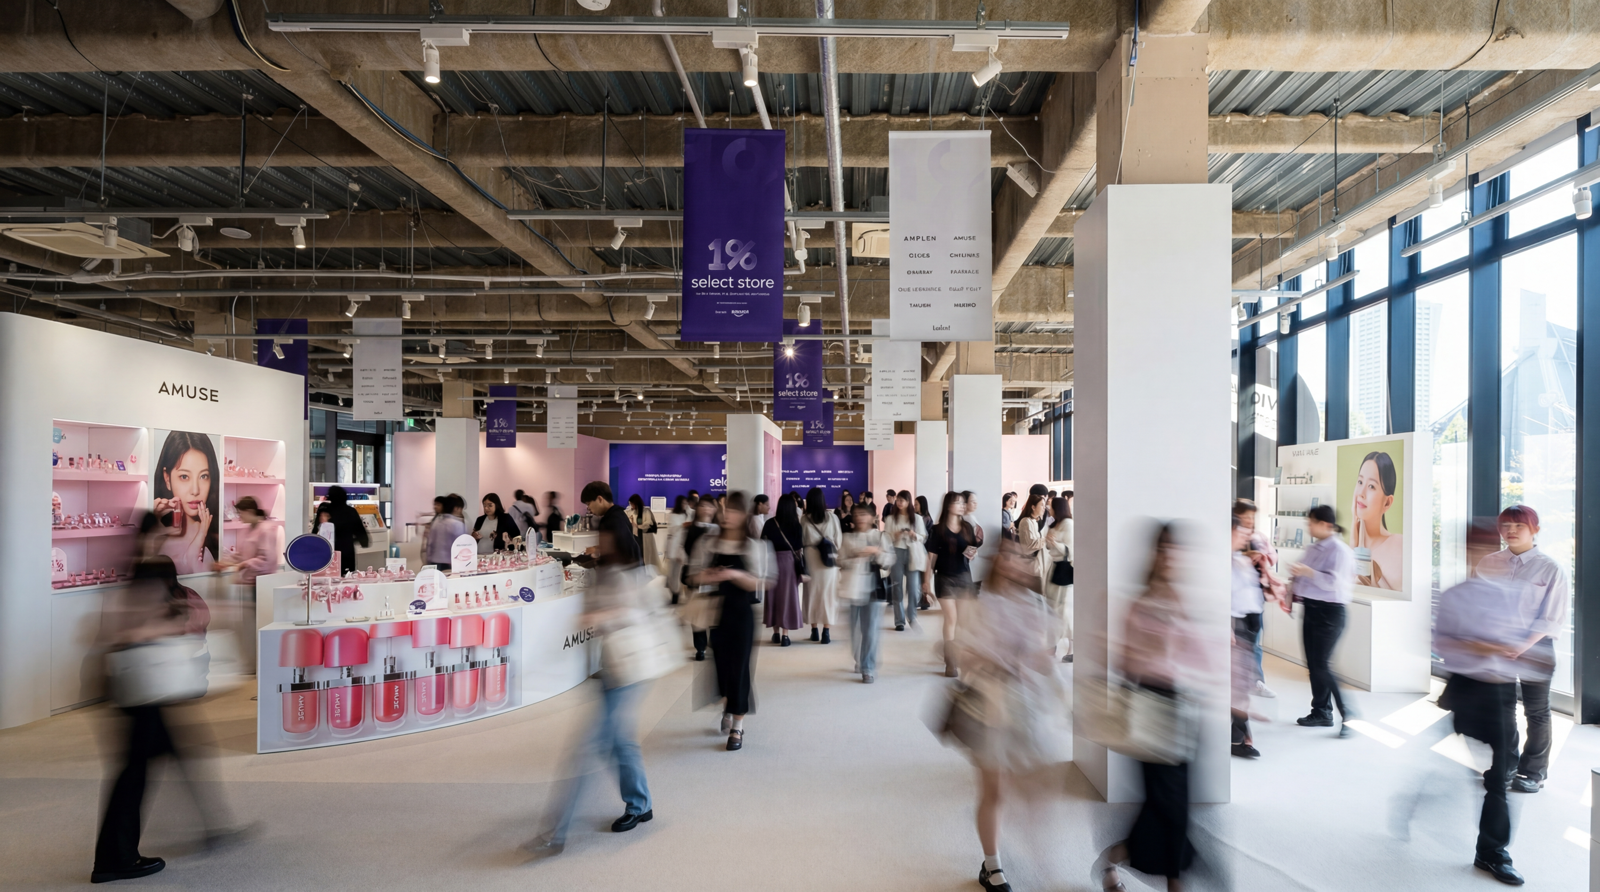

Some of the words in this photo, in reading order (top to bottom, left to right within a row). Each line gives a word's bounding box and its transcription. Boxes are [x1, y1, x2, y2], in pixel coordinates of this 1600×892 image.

[707, 238, 758, 271] 1%
[691, 275, 735, 289] select
[737, 276, 775, 289] store
[158, 380, 220, 403] AMUSE
